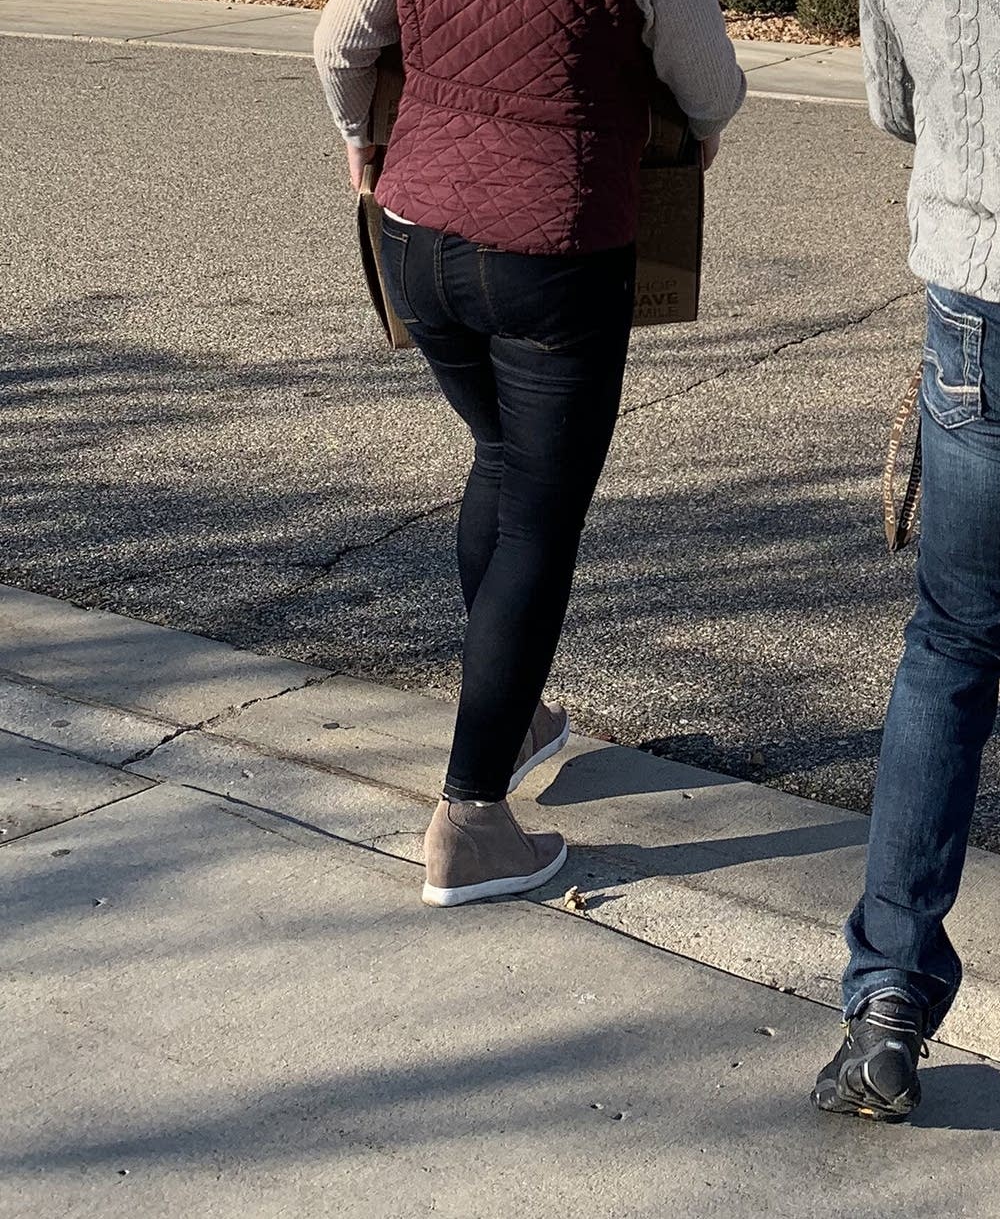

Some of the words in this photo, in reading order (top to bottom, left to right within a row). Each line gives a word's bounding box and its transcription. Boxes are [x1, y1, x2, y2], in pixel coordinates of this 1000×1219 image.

[637, 279, 677, 293] HOP
[635, 306, 681, 318] MILE
[892, 387, 919, 433] STATE
[882, 439, 900, 524] UNIVERSITY
